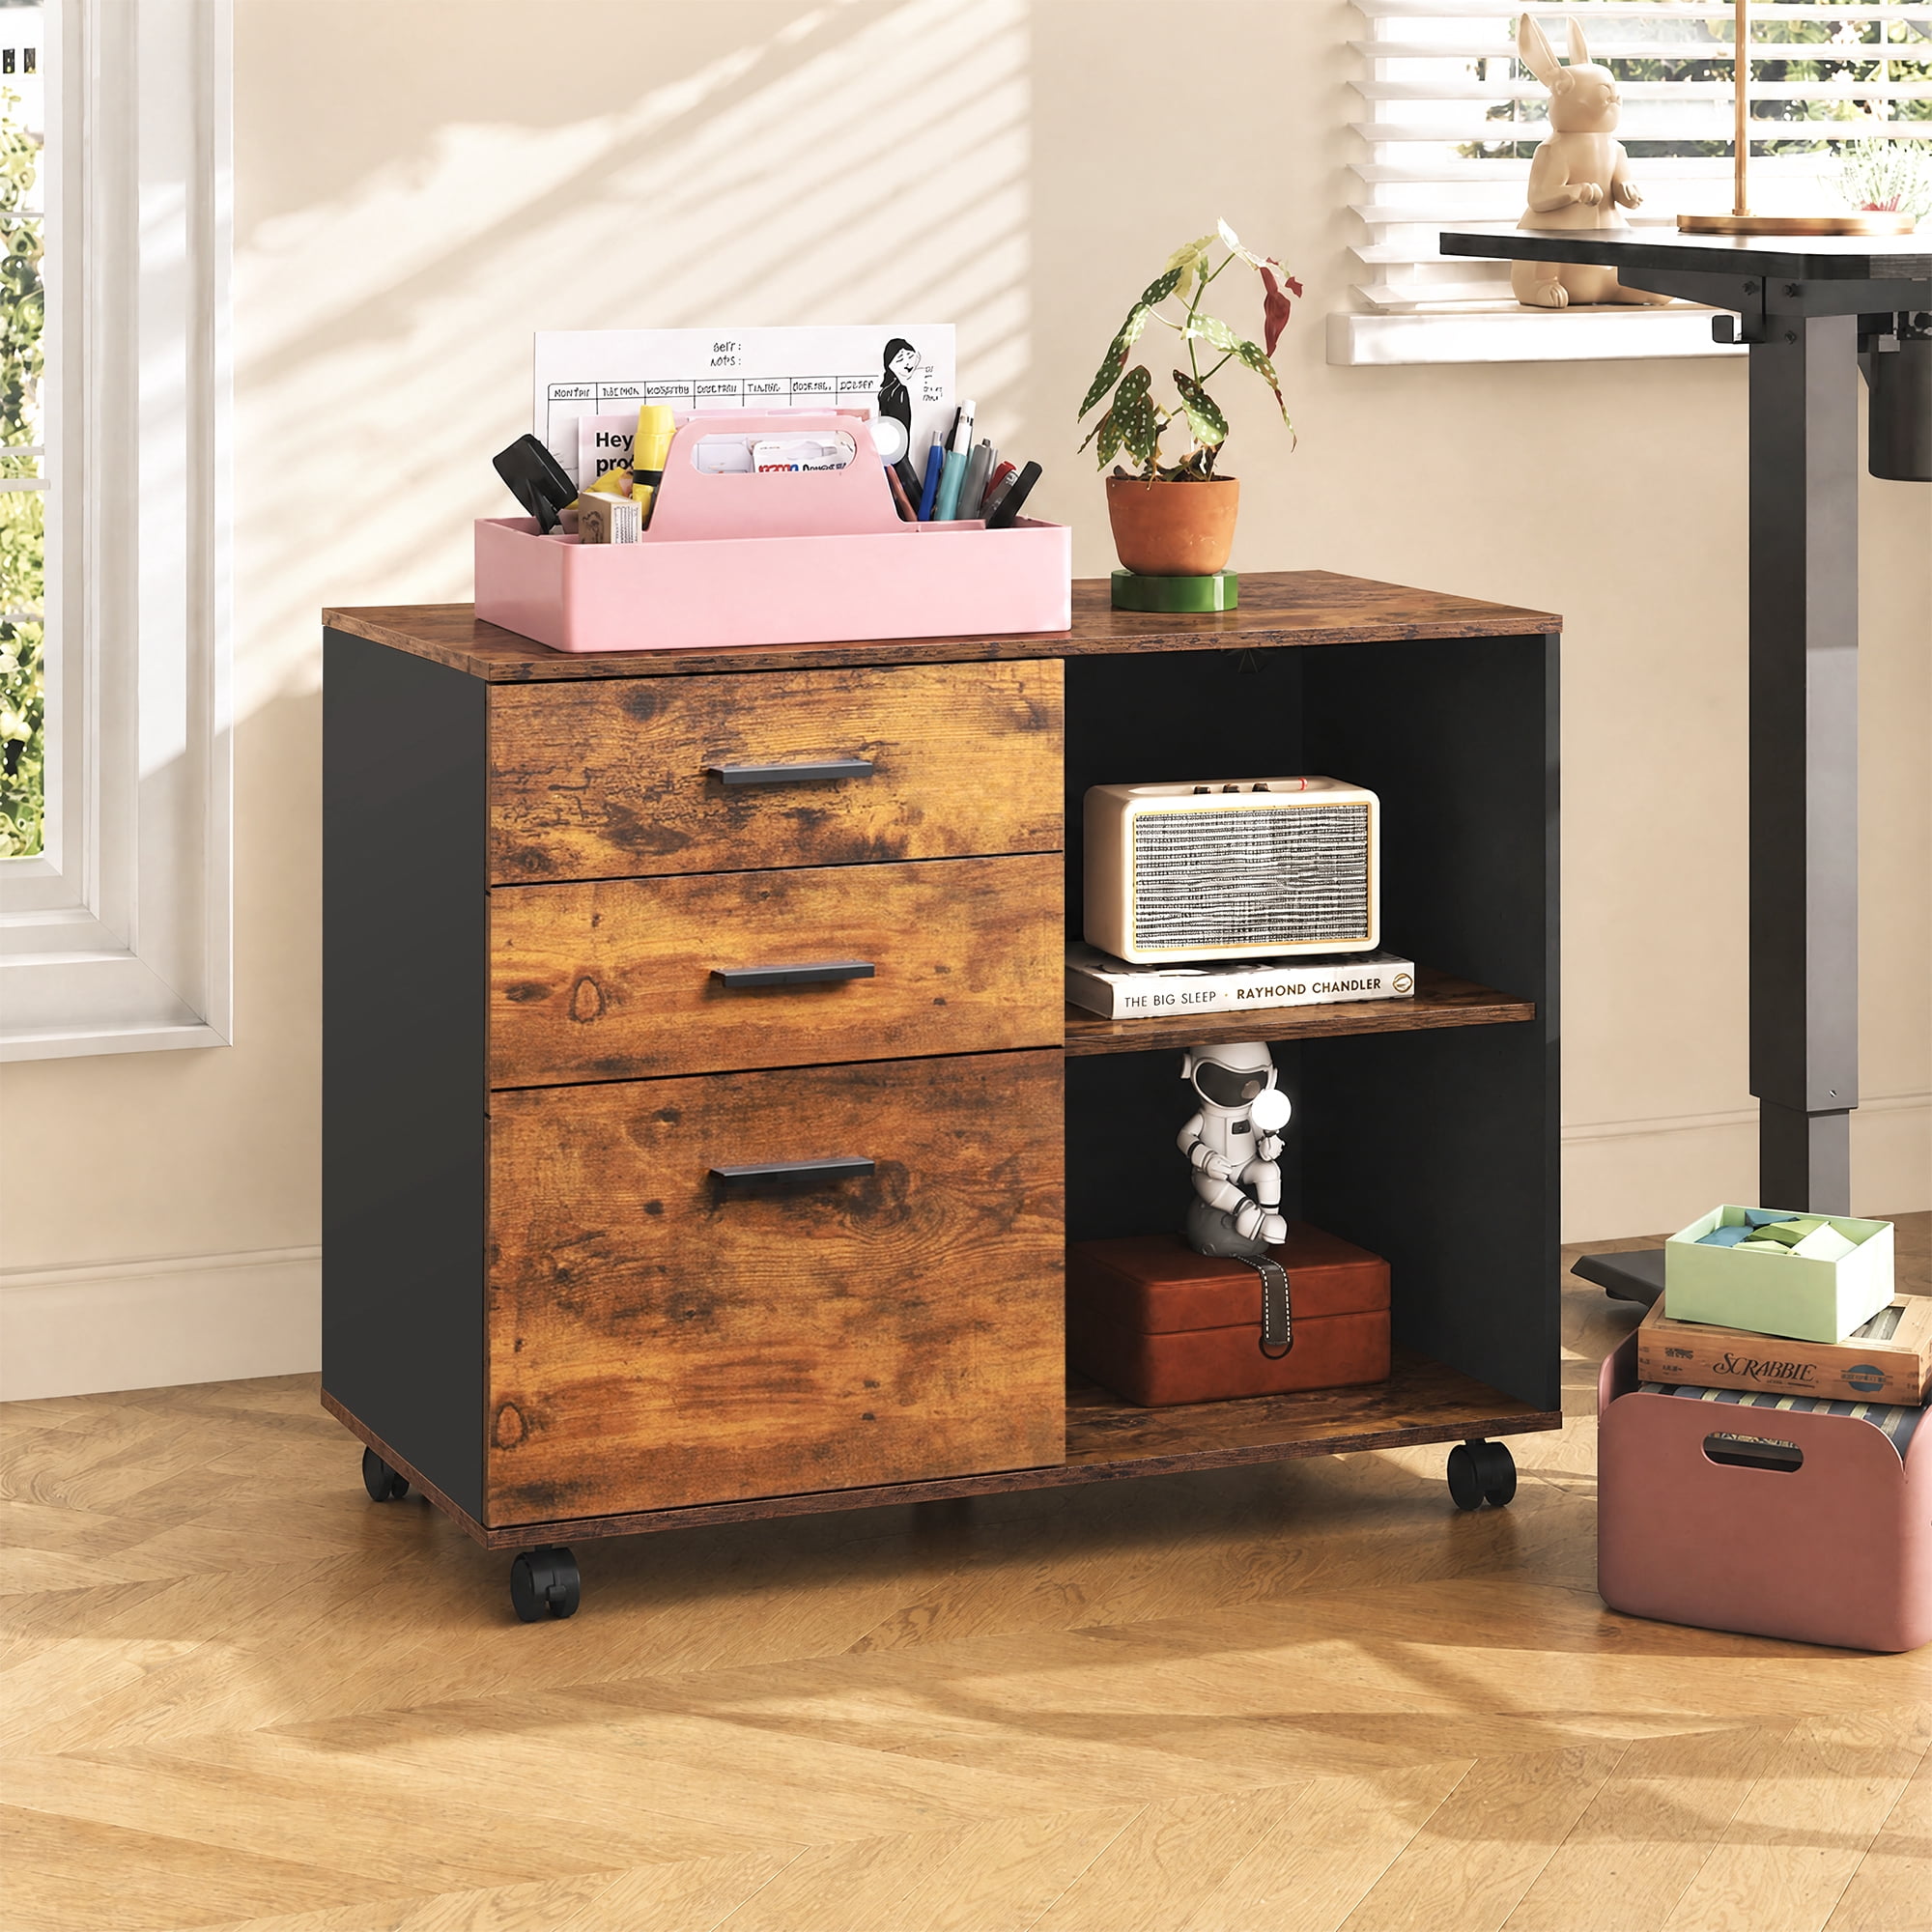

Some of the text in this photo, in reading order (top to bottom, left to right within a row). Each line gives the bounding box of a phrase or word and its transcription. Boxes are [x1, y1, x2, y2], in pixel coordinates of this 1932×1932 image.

[595, 432, 634, 452] Hey
[1124, 996, 1148, 1008] THE
[1153, 994, 1176, 1006] BIG
[1180, 991, 1216, 1005] SLEEP
[1312, 978, 1381, 994] CHANDLER
